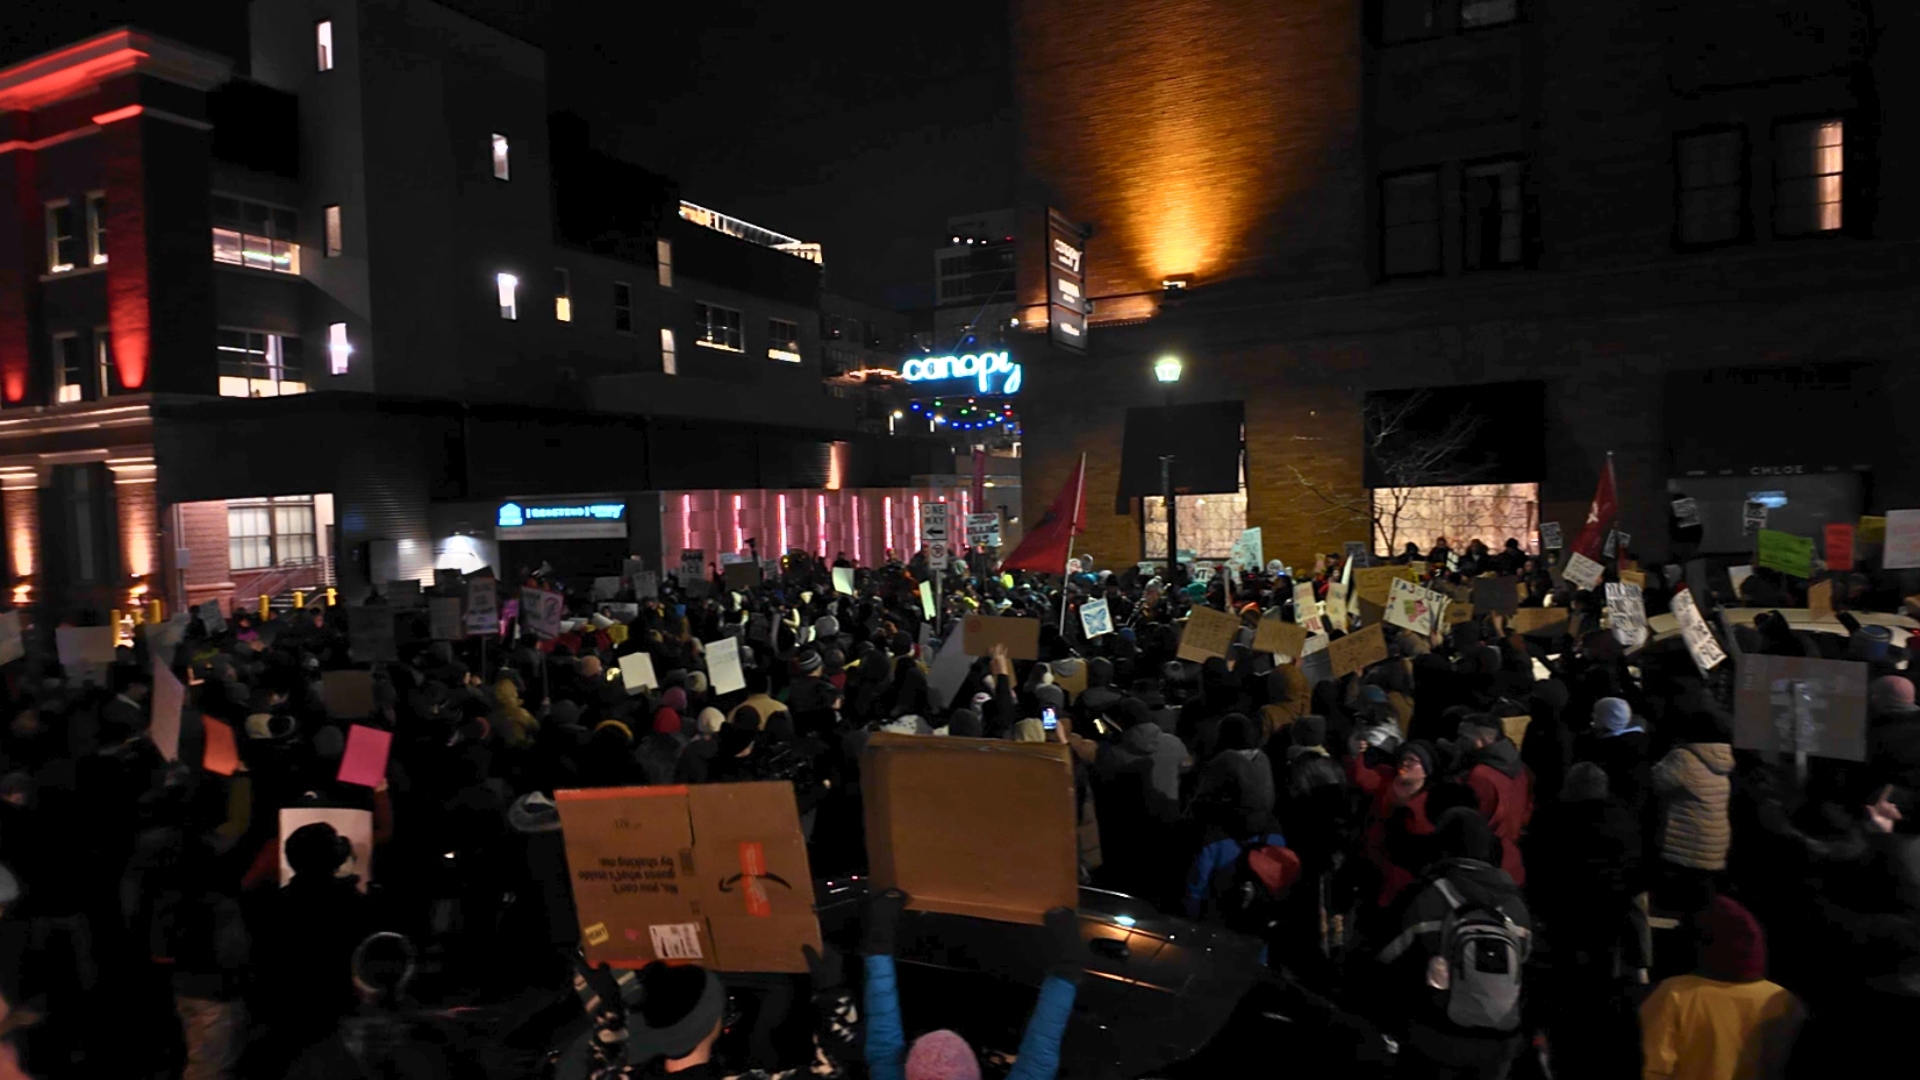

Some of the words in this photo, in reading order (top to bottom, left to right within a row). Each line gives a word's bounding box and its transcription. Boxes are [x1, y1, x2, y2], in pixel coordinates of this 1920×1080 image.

[902, 351, 1023, 394] canopy
[1749, 464, 1805, 475] CHLOE
[924, 506, 944, 515] ONE
[924, 517, 944, 525] WAY
[617, 857, 659, 868] shaking
[661, 854, 674, 868] by
[578, 870, 608, 881] inside
[608, 870, 643, 881] what's
[644, 868, 675, 880] guess
[612, 883, 639, 894] can't
[640, 882, 660, 893] you
